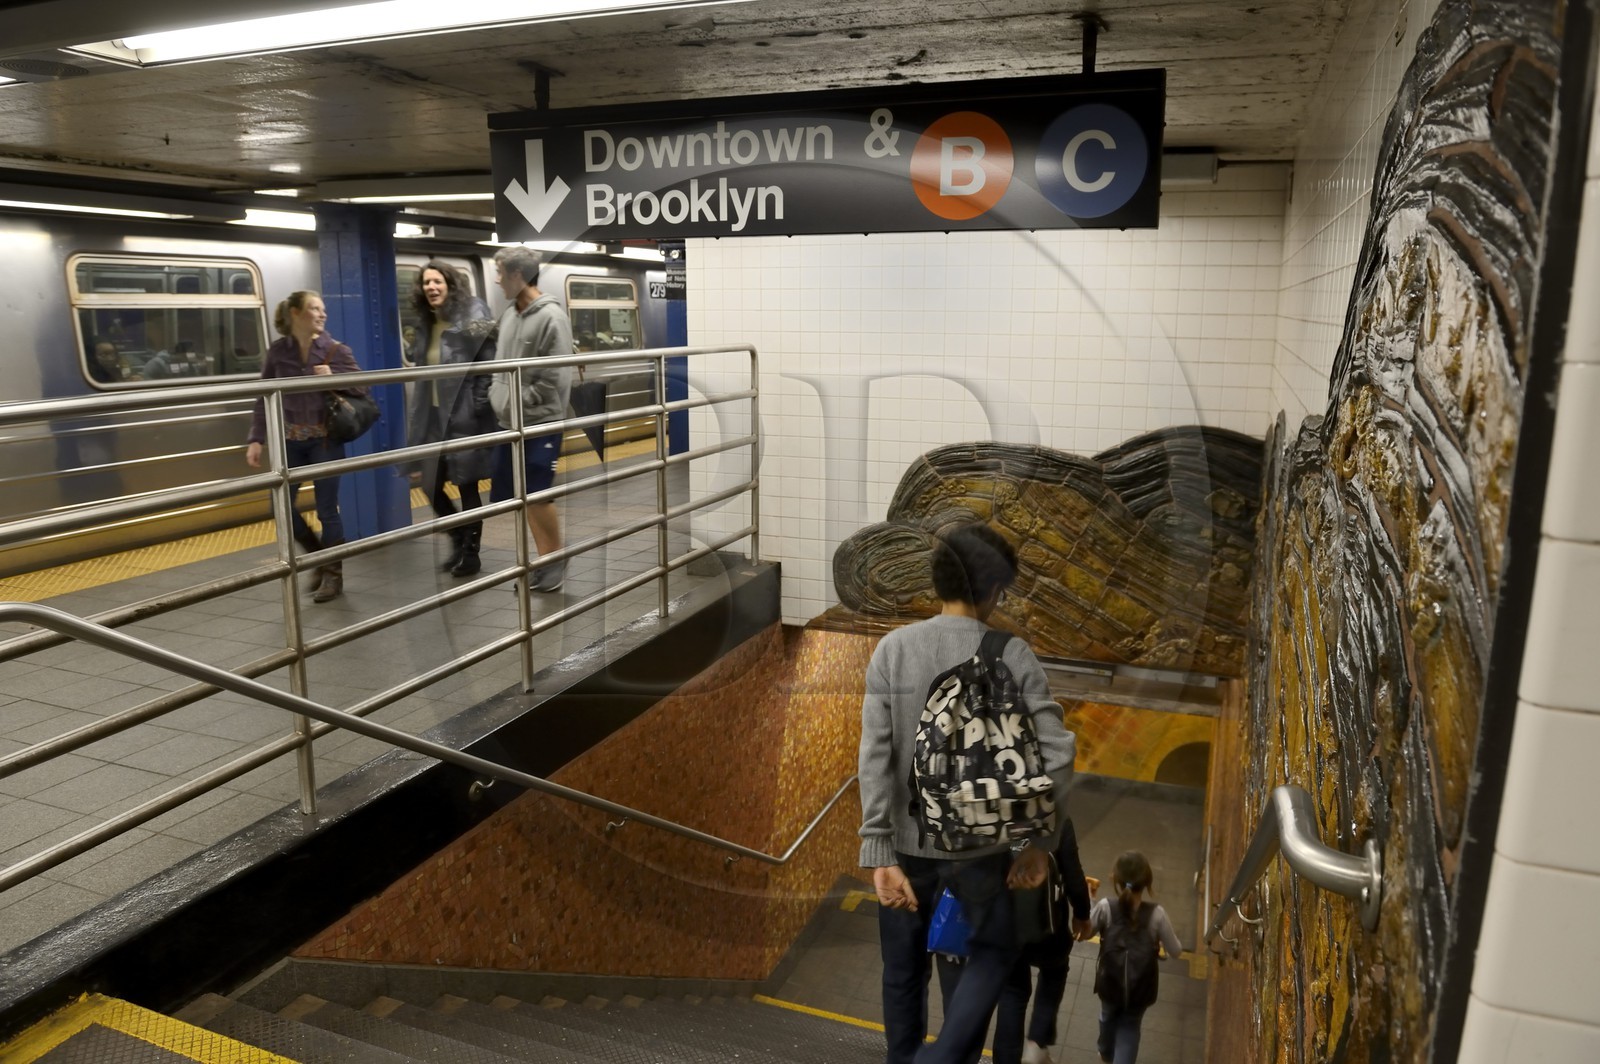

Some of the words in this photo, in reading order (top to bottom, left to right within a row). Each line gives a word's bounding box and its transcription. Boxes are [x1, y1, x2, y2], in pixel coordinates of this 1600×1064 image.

[584, 121, 833, 172] Downtown
[863, 108, 900, 158] &
[940, 136, 986, 196] B
[1062, 129, 1116, 192] C
[586, 178, 784, 232] Brooklyn
[651, 283, 666, 298] 279
